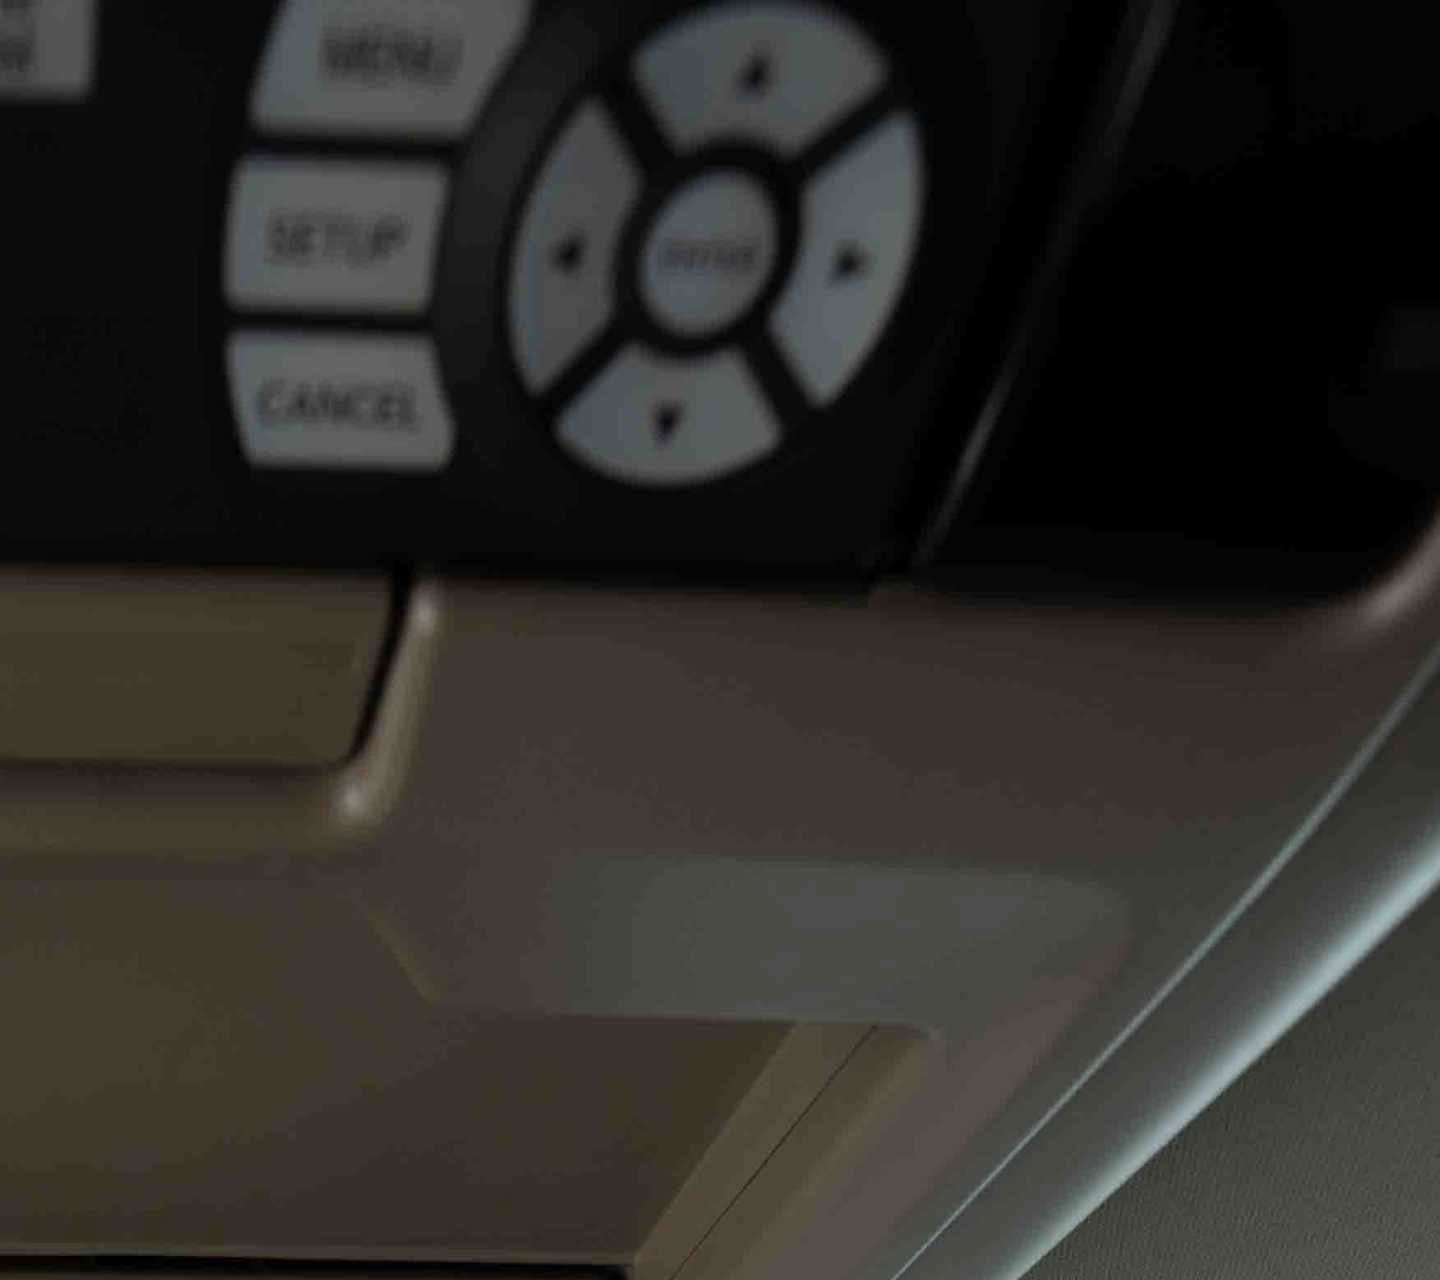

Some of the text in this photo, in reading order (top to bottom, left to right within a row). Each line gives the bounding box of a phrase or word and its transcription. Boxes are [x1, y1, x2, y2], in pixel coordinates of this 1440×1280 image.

[320, 26, 463, 83] MENU
[267, 210, 409, 267] SETUP
[256, 378, 419, 432] CANCEL
